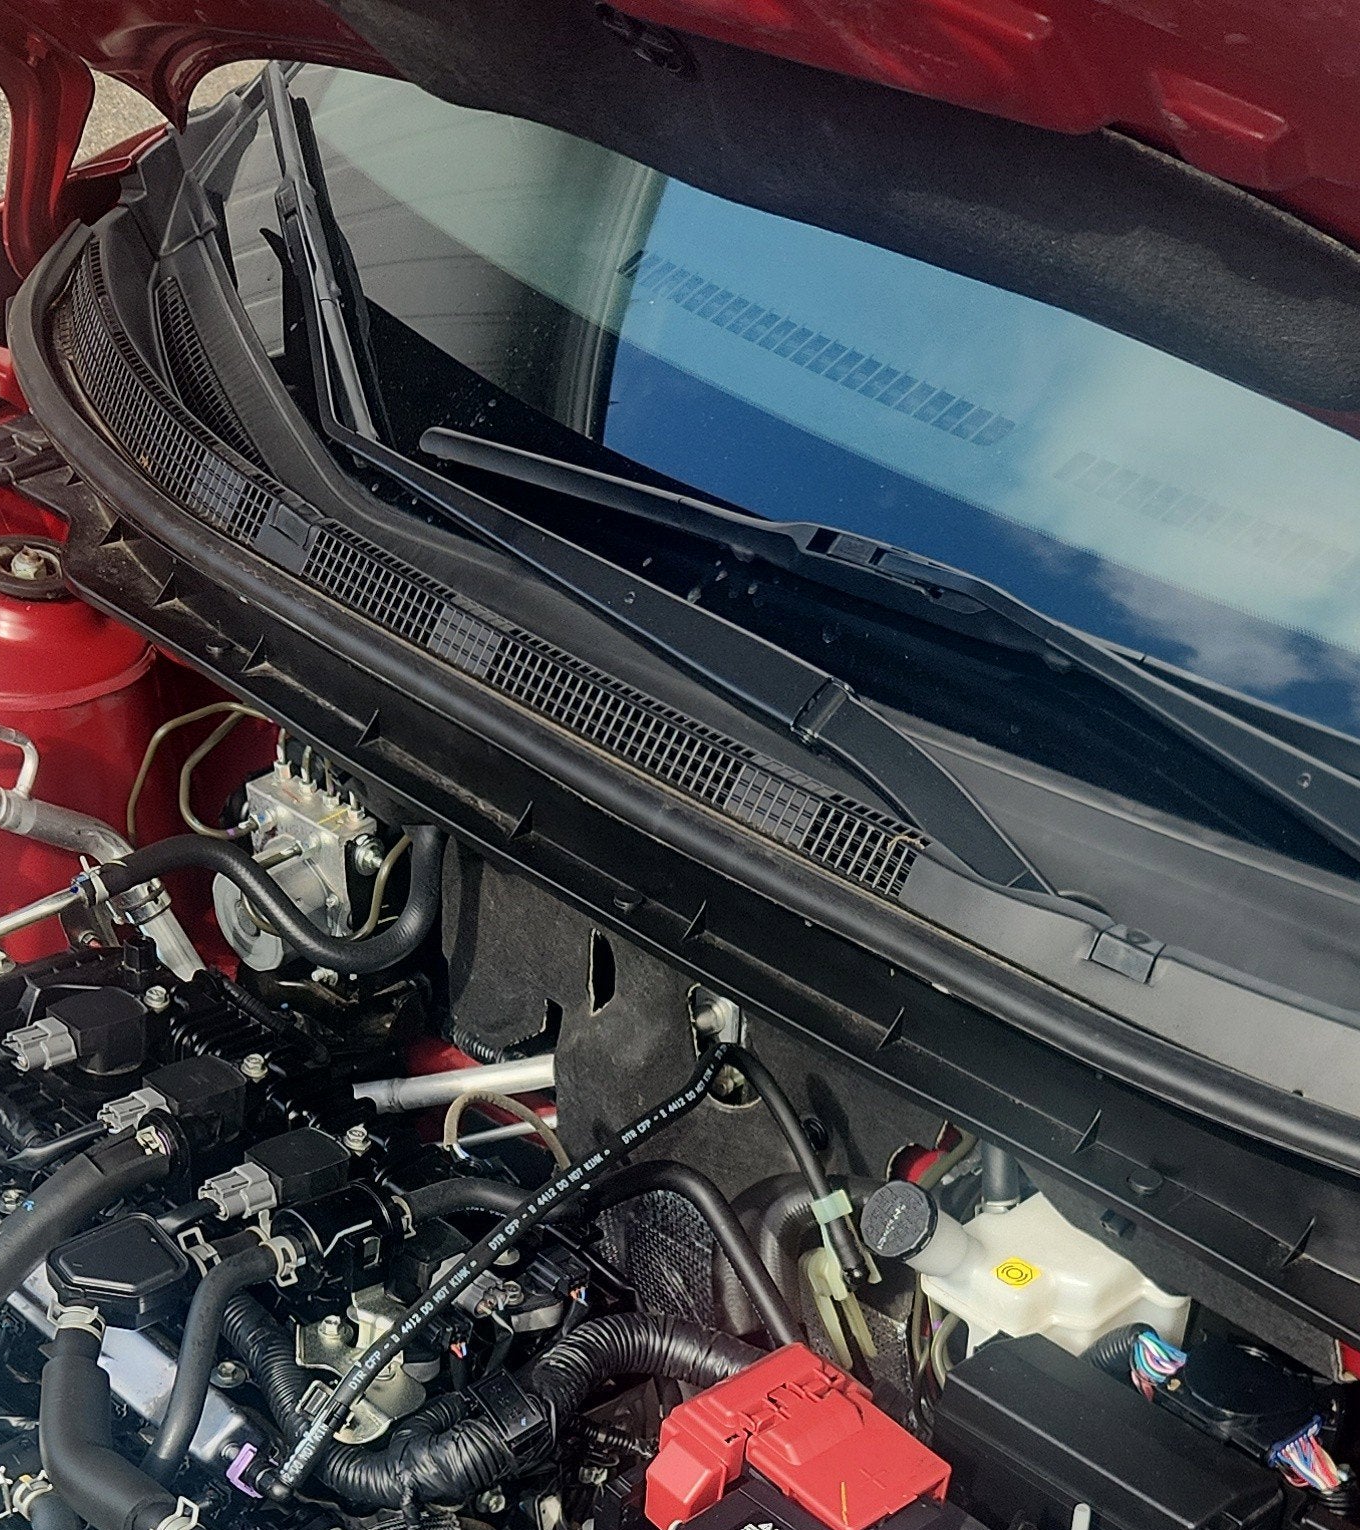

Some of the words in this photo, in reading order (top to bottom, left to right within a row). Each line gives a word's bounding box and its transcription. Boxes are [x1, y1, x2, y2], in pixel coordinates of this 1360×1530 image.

[535, 1186, 558, 1207] 4412
[555, 1177, 570, 1192] DO
[347, 1367, 368, 1392] DTR
[363, 1348, 384, 1371] CFP
[397, 1310, 422, 1336] 4412
[417, 1298, 436, 1316] DO
[430, 1283, 451, 1304] NOT
